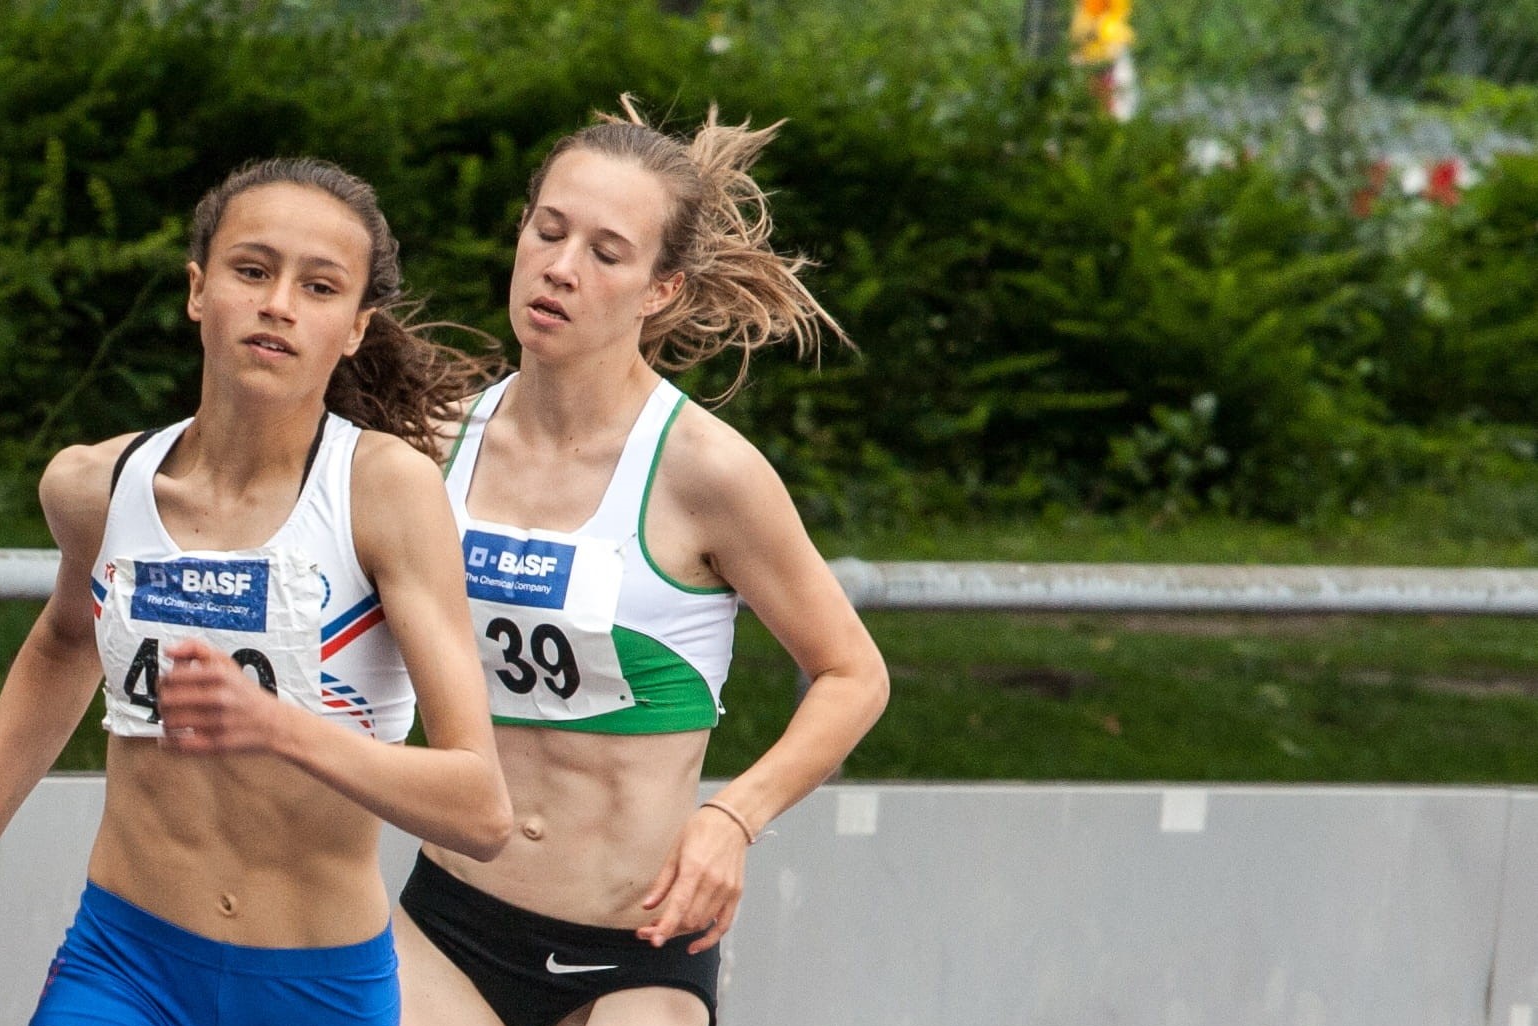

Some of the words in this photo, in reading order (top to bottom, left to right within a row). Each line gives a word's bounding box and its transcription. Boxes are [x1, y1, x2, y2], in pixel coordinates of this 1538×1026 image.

[497, 551, 558, 577] BASF
[182, 569, 252, 596] BASF
[465, 572, 479, 583] The
[480, 575, 514, 590] Chemical
[514, 581, 552, 595] Company
[147, 594, 163, 605] The
[164, 596, 206, 611] Chemical
[206, 601, 250, 616] Company
[485, 617, 581, 701] 39
